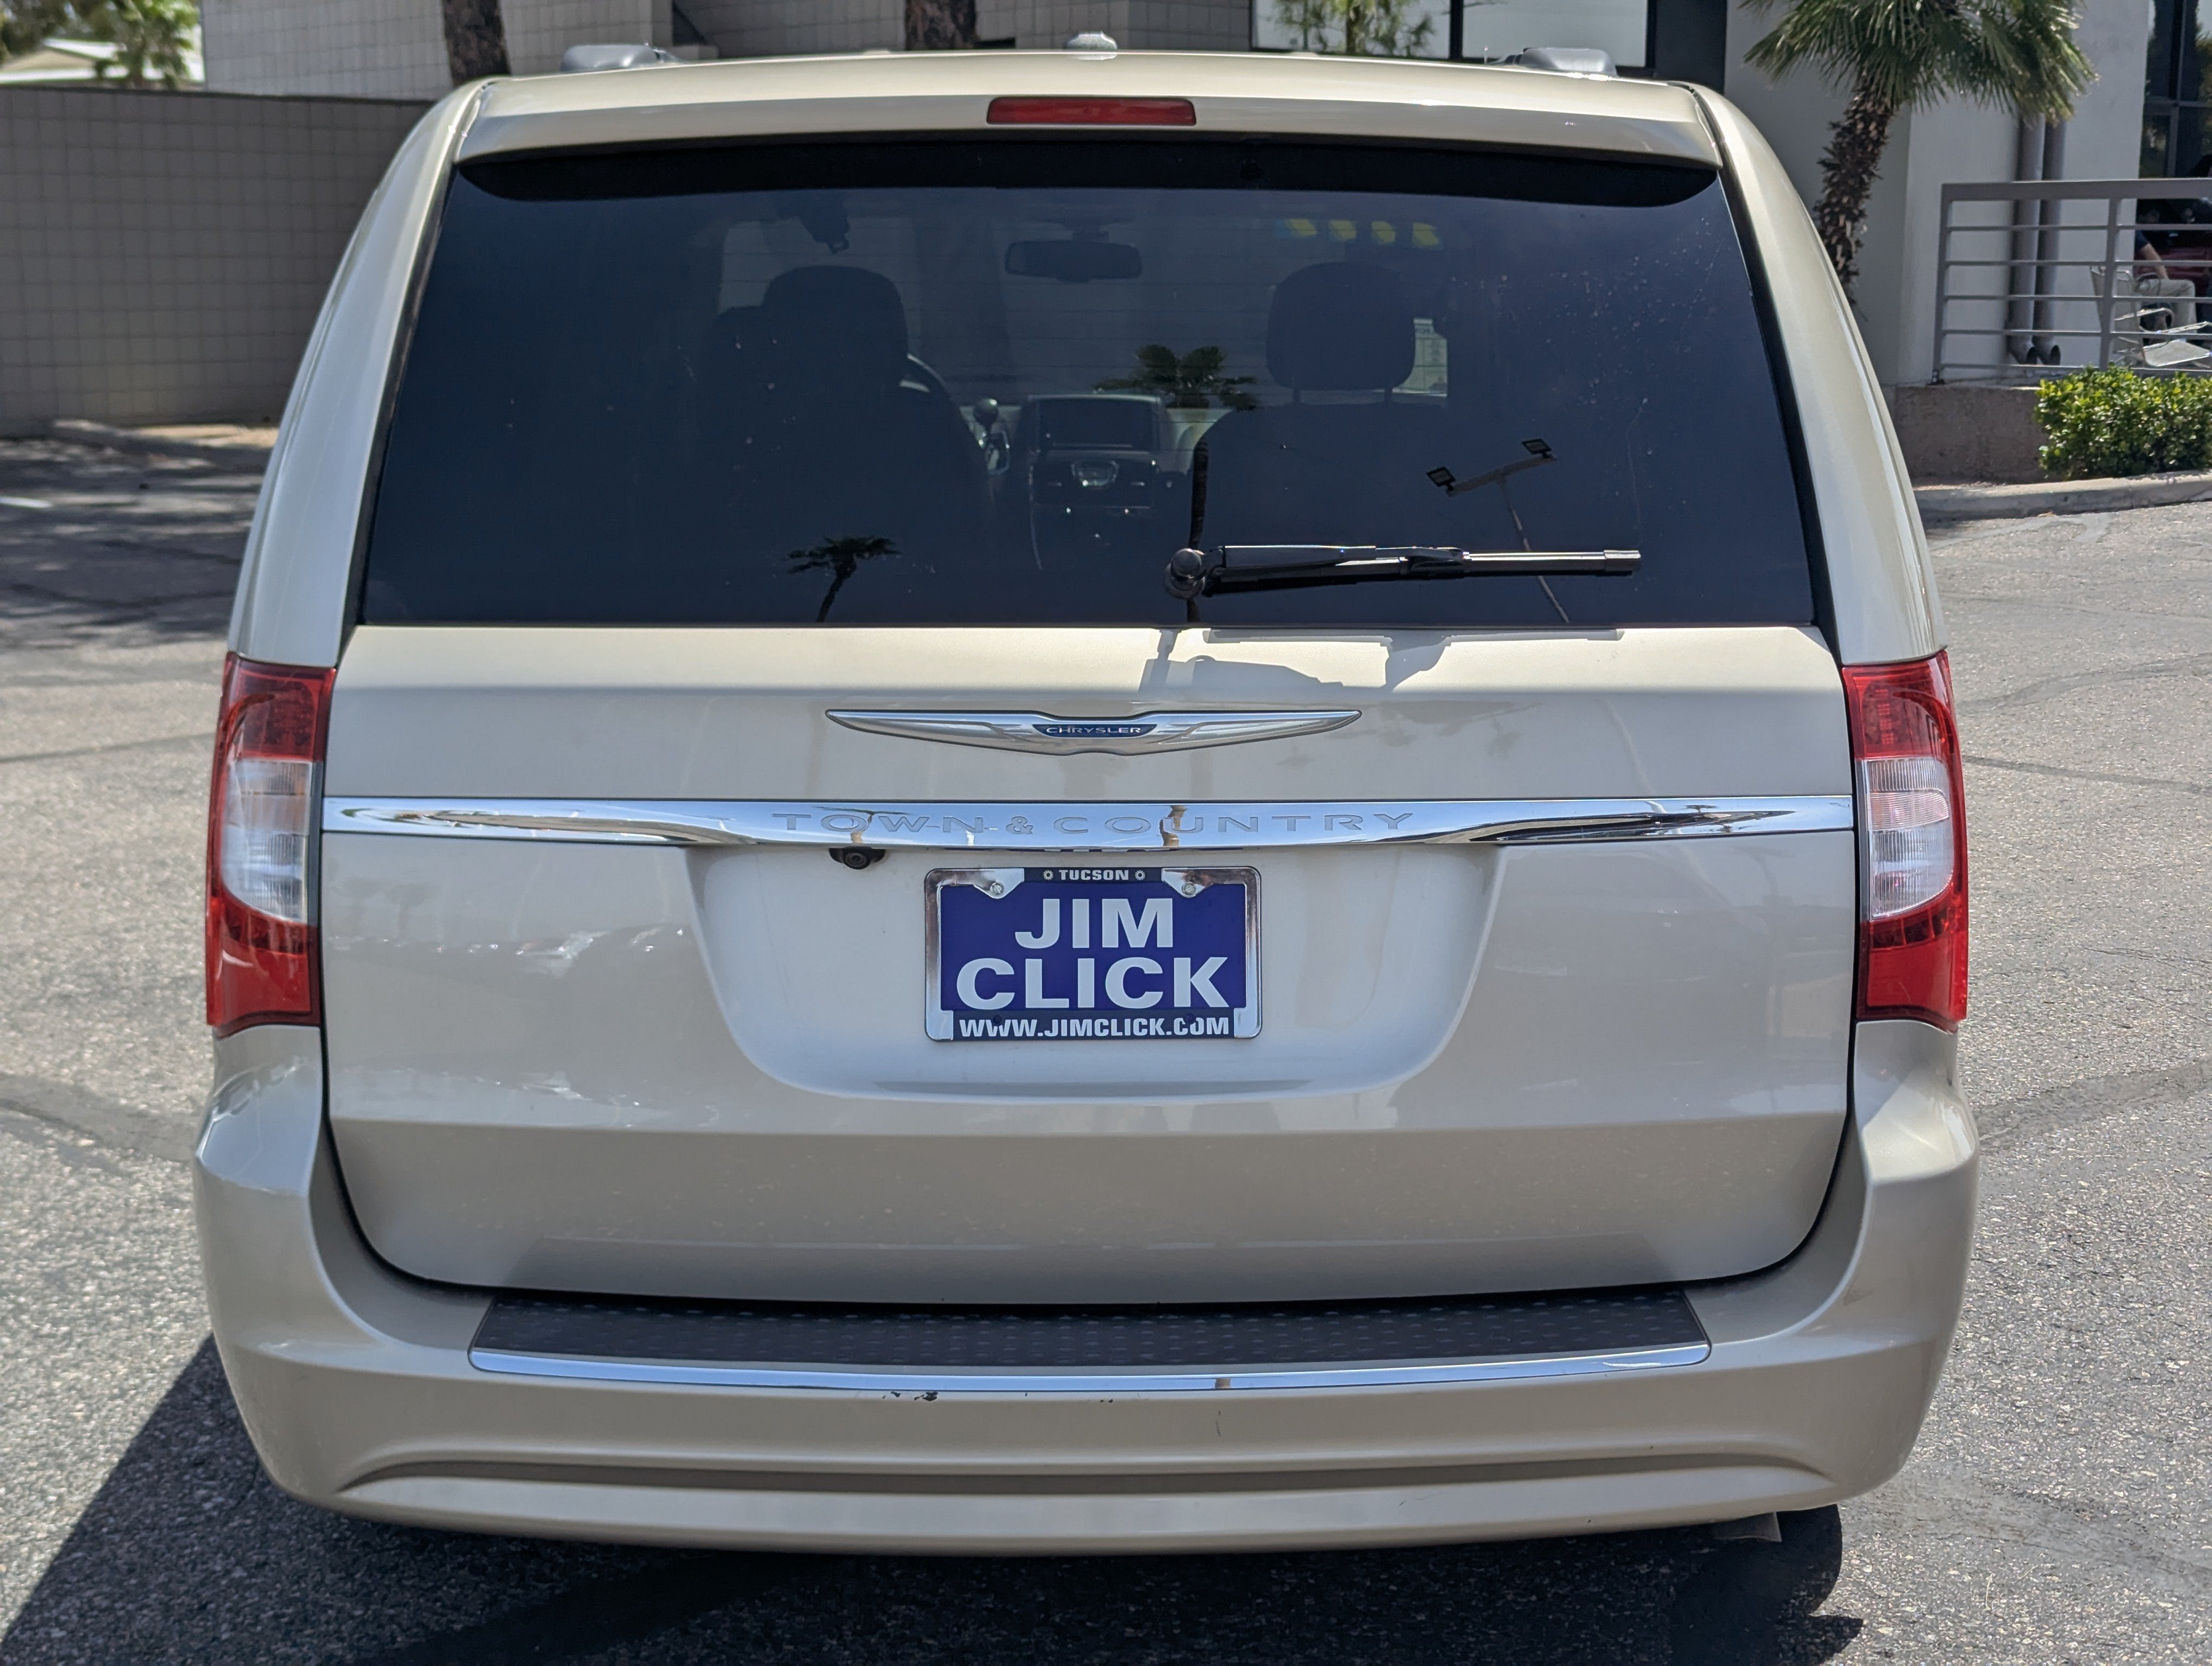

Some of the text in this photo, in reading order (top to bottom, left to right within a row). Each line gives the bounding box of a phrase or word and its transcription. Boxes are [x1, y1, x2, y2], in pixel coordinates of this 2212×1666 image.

[772, 813, 1413, 834] TOWN & COUNTRY
[1058, 869, 1129, 880] TUCSON
[1015, 898, 1173, 949] JIM
[956, 957, 1230, 1010] CLICK
[960, 1017, 1229, 1037] WWW.JIMCLICK.COM
